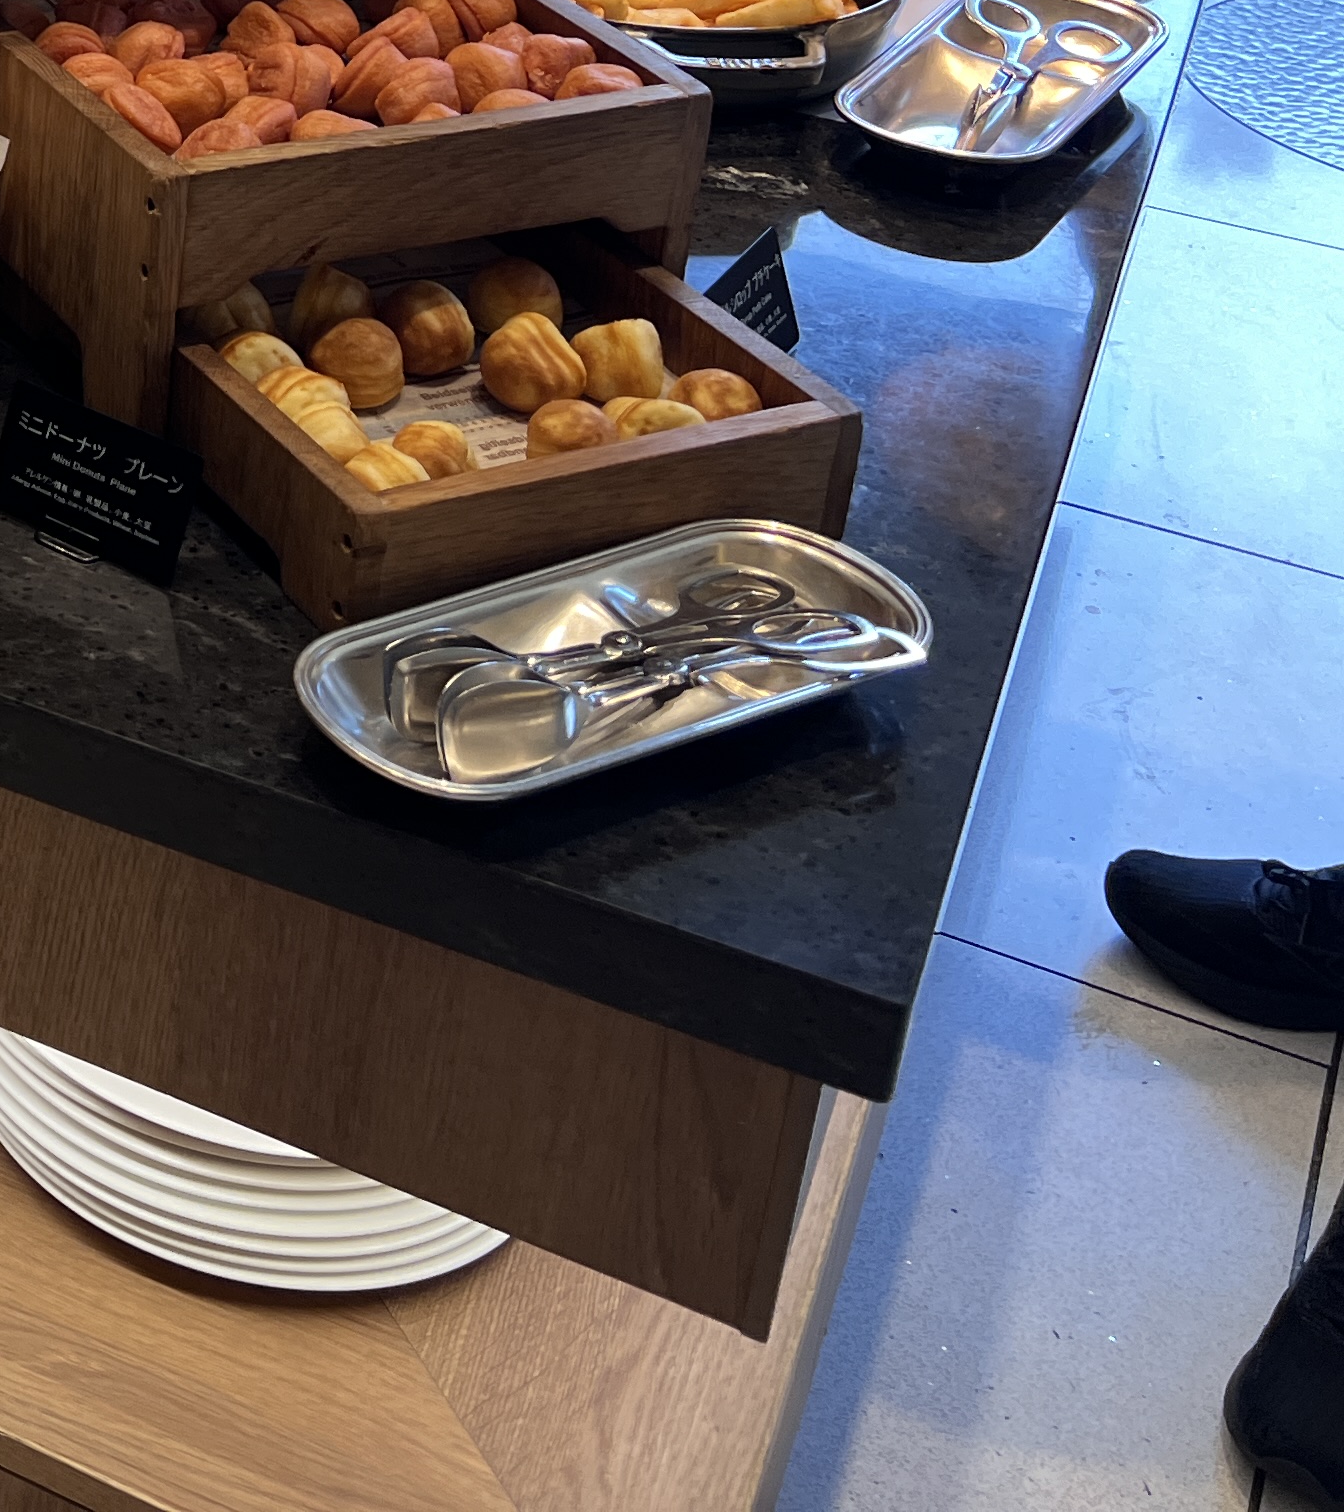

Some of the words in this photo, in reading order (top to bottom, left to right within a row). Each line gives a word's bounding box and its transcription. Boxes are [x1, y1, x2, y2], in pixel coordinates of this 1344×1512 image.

[18, 410, 107, 460] ミニドーナツ
[123, 457, 184, 494] プレーン
[51, 452, 71, 467] Mini
